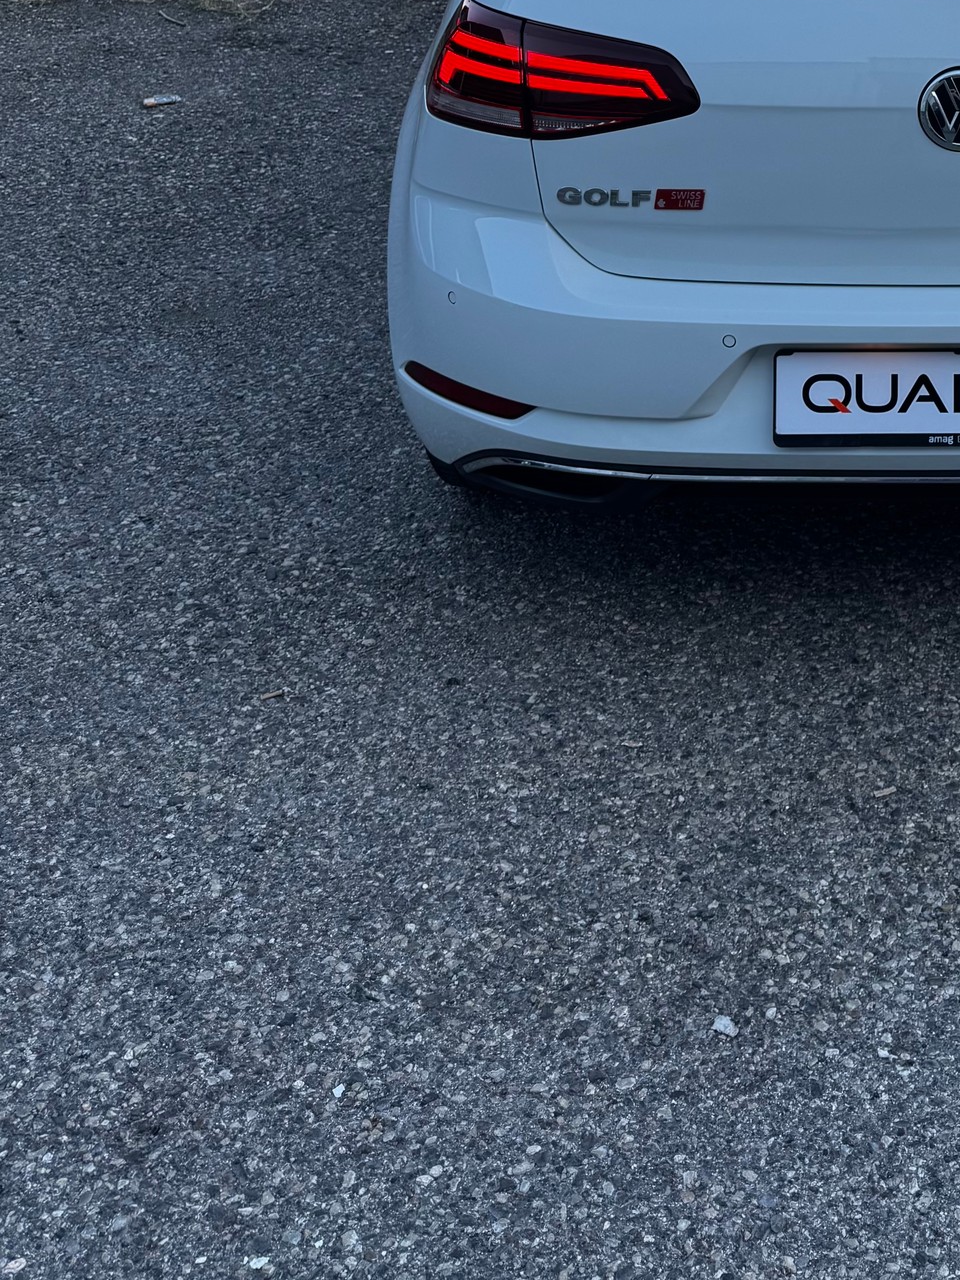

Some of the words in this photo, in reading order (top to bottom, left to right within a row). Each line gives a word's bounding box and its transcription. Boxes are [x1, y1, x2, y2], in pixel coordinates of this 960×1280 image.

[556, 186, 652, 208] GOLF
[671, 191, 701, 200] SWISS
[678, 199, 701, 208] LINE
[928, 435, 954, 445] amag
